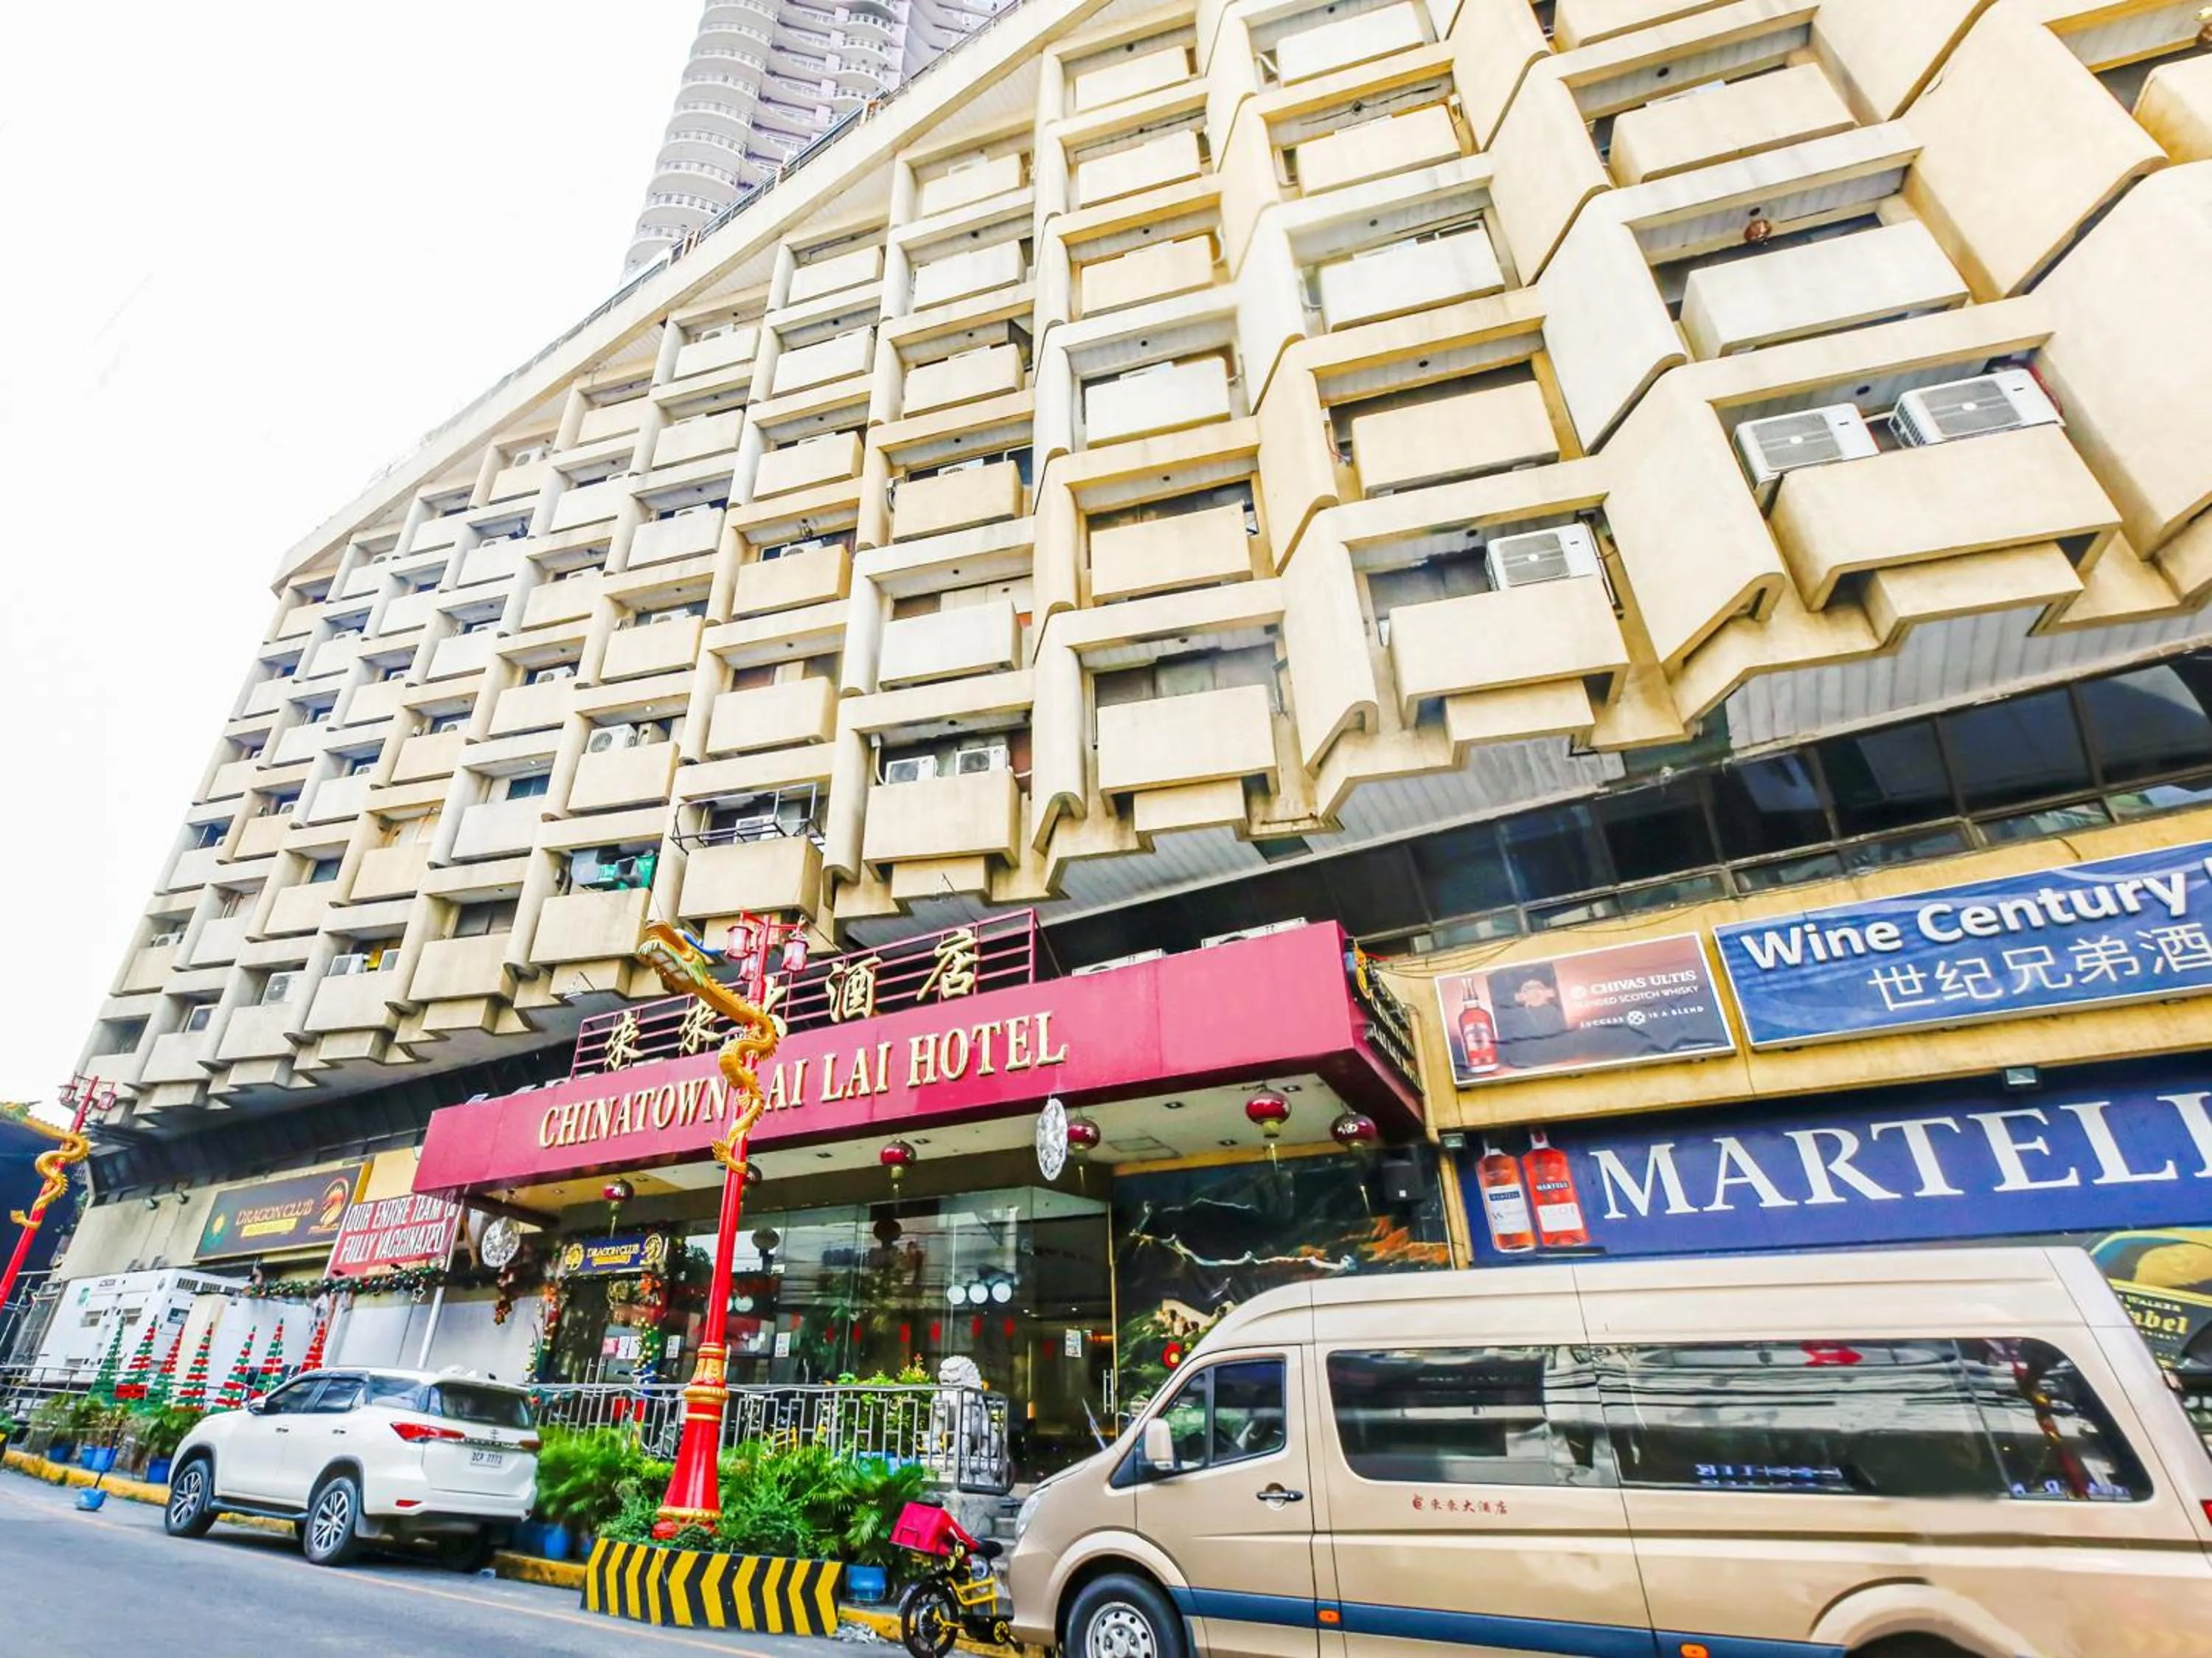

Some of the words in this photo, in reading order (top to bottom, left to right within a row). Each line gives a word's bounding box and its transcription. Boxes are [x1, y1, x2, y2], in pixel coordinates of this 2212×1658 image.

[1740, 920, 1902, 971] Wine
[1916, 872, 2187, 944] Century
[1590, 977, 1646, 994] CHIVAS
[1620, 991, 1660, 1003] SCOTCH
[1660, 985, 1700, 998] WHISKY
[539, 1075, 728, 1149] CHINATOWN
[759, 1058, 809, 1112] AI
[820, 1041, 893, 1103] LAI
[907, 1011, 1068, 1088] HOTEL
[338, 1232, 379, 1264] FULLY
[374, 1221, 447, 1260] VACCINATED
[2126, 1306, 2189, 1335] abel
